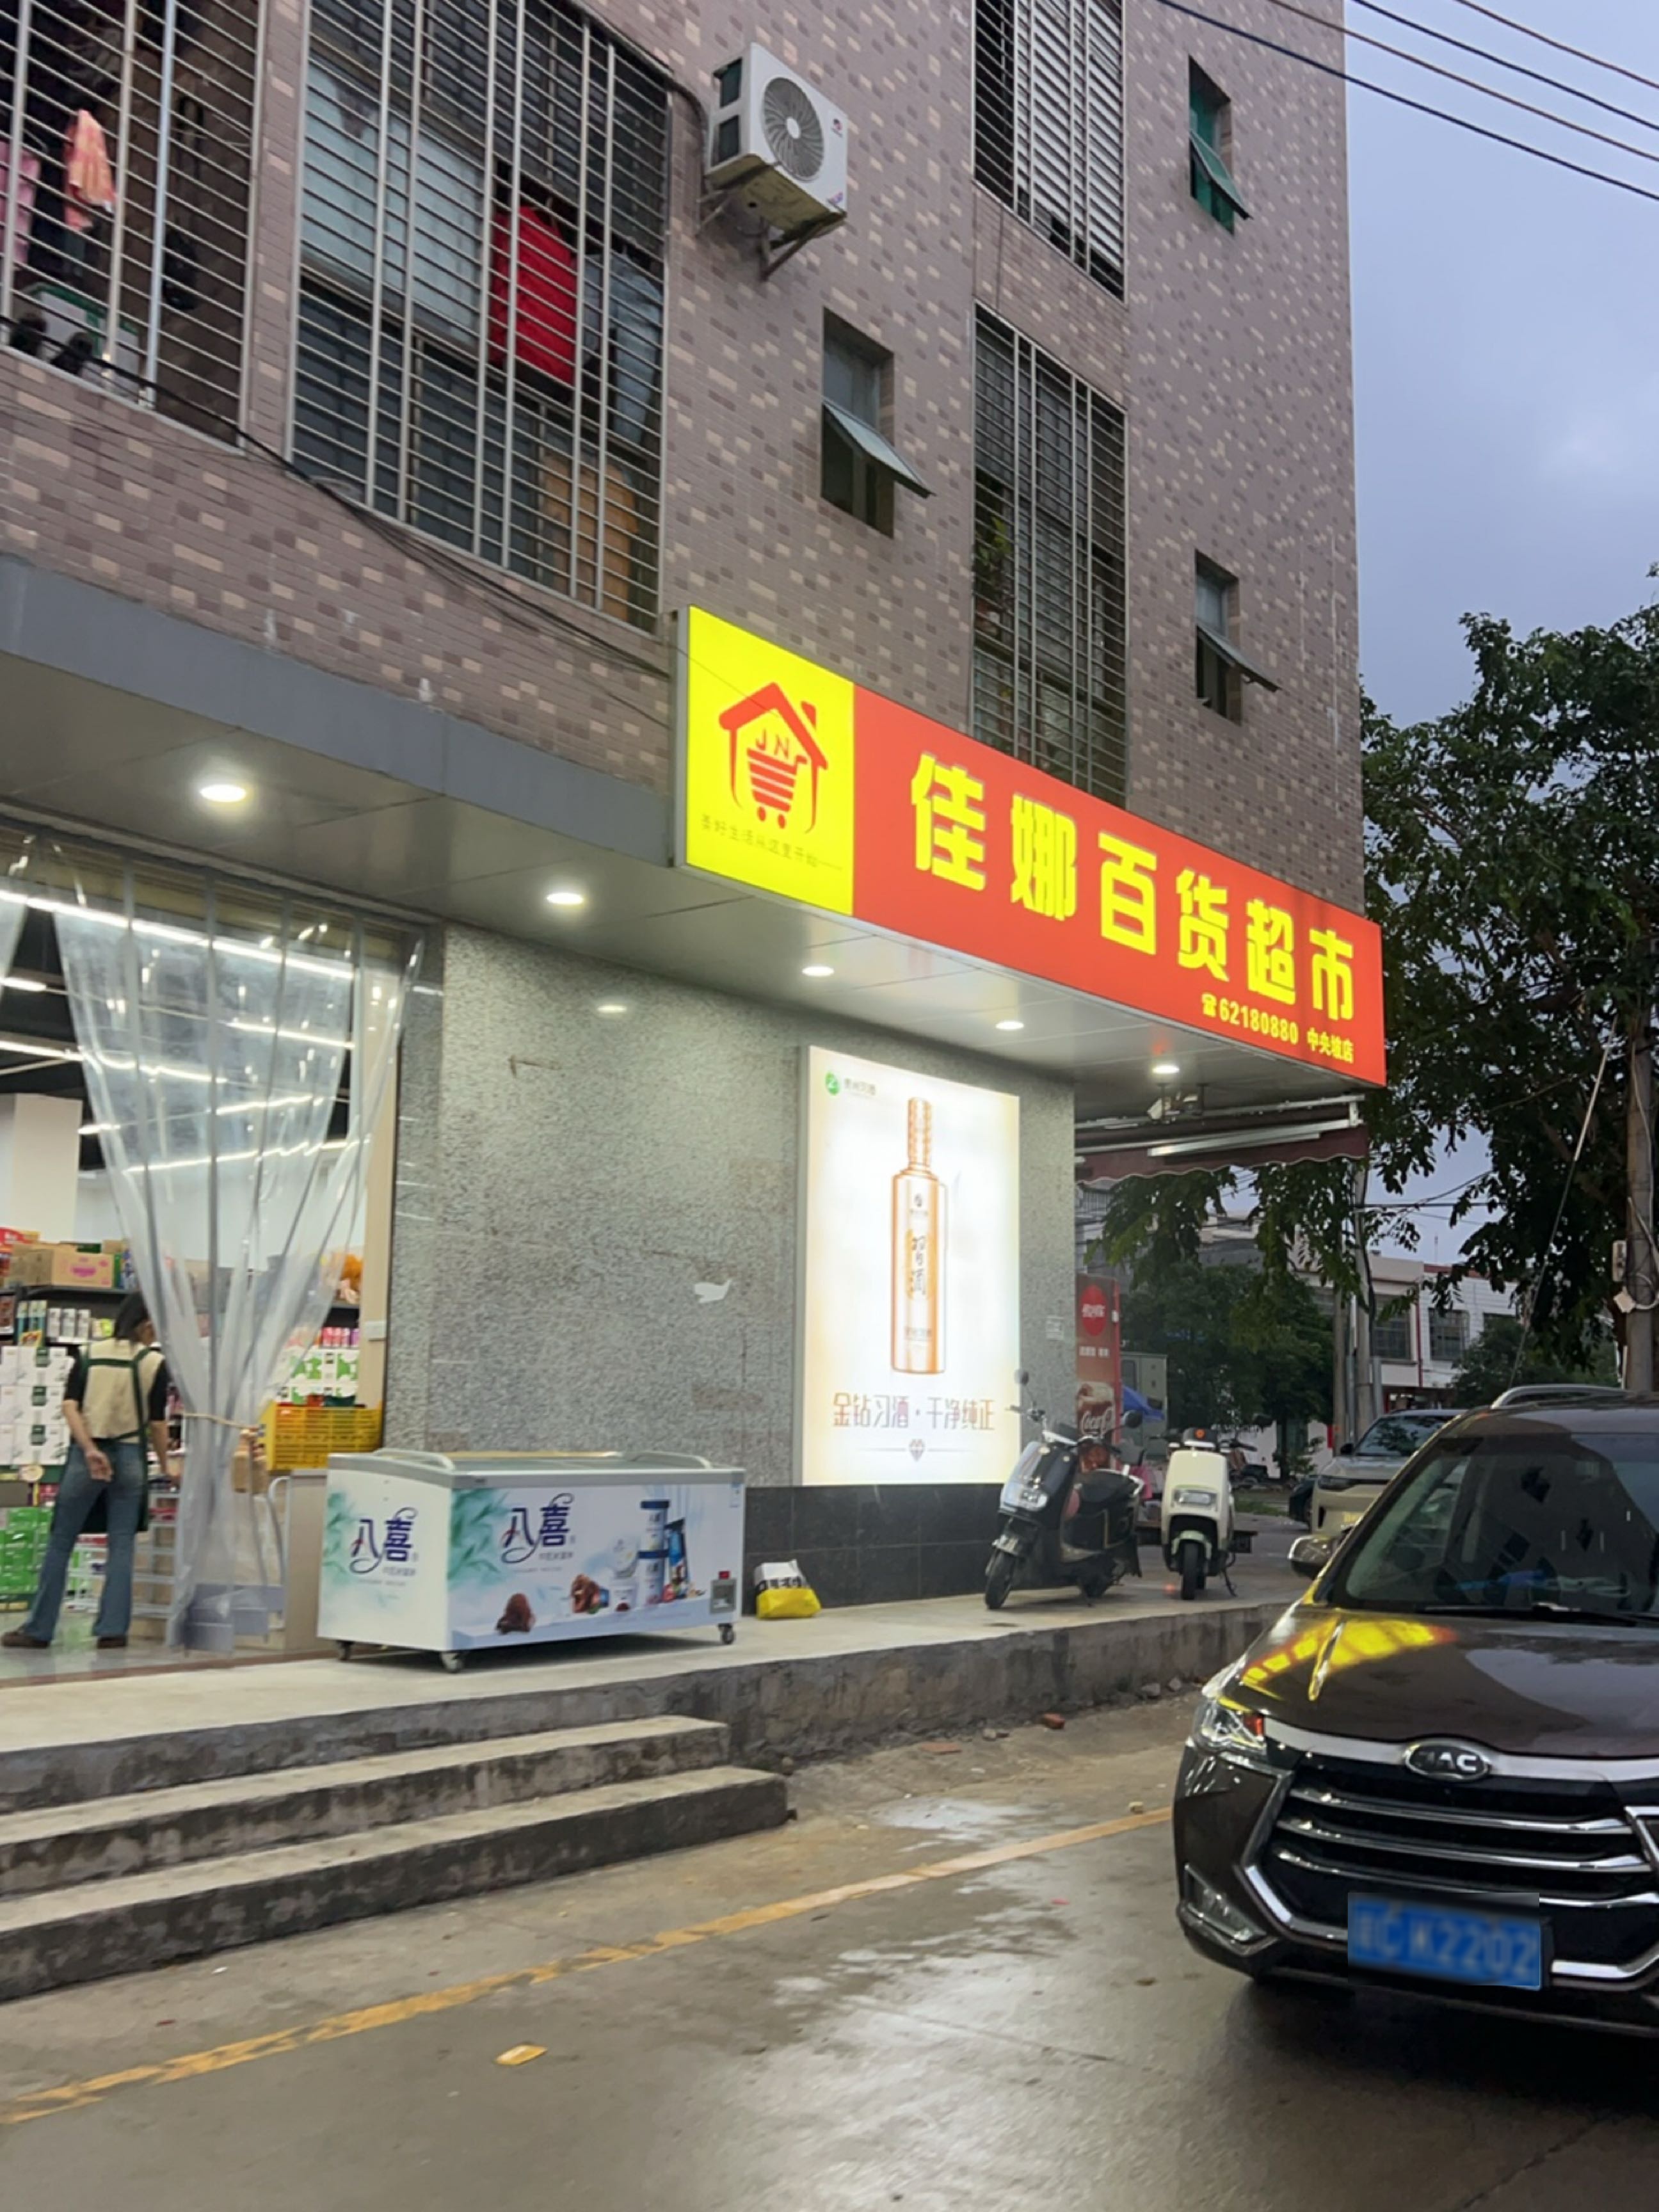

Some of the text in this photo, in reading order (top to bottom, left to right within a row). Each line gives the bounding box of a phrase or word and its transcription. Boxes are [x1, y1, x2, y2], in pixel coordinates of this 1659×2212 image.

[911, 751, 1354, 1021] 佳娜百货超市
[1219, 997, 1299, 1045] 62180880
[349, 1508, 417, 1568] 八喜
[502, 1495, 572, 1557] 八喜
